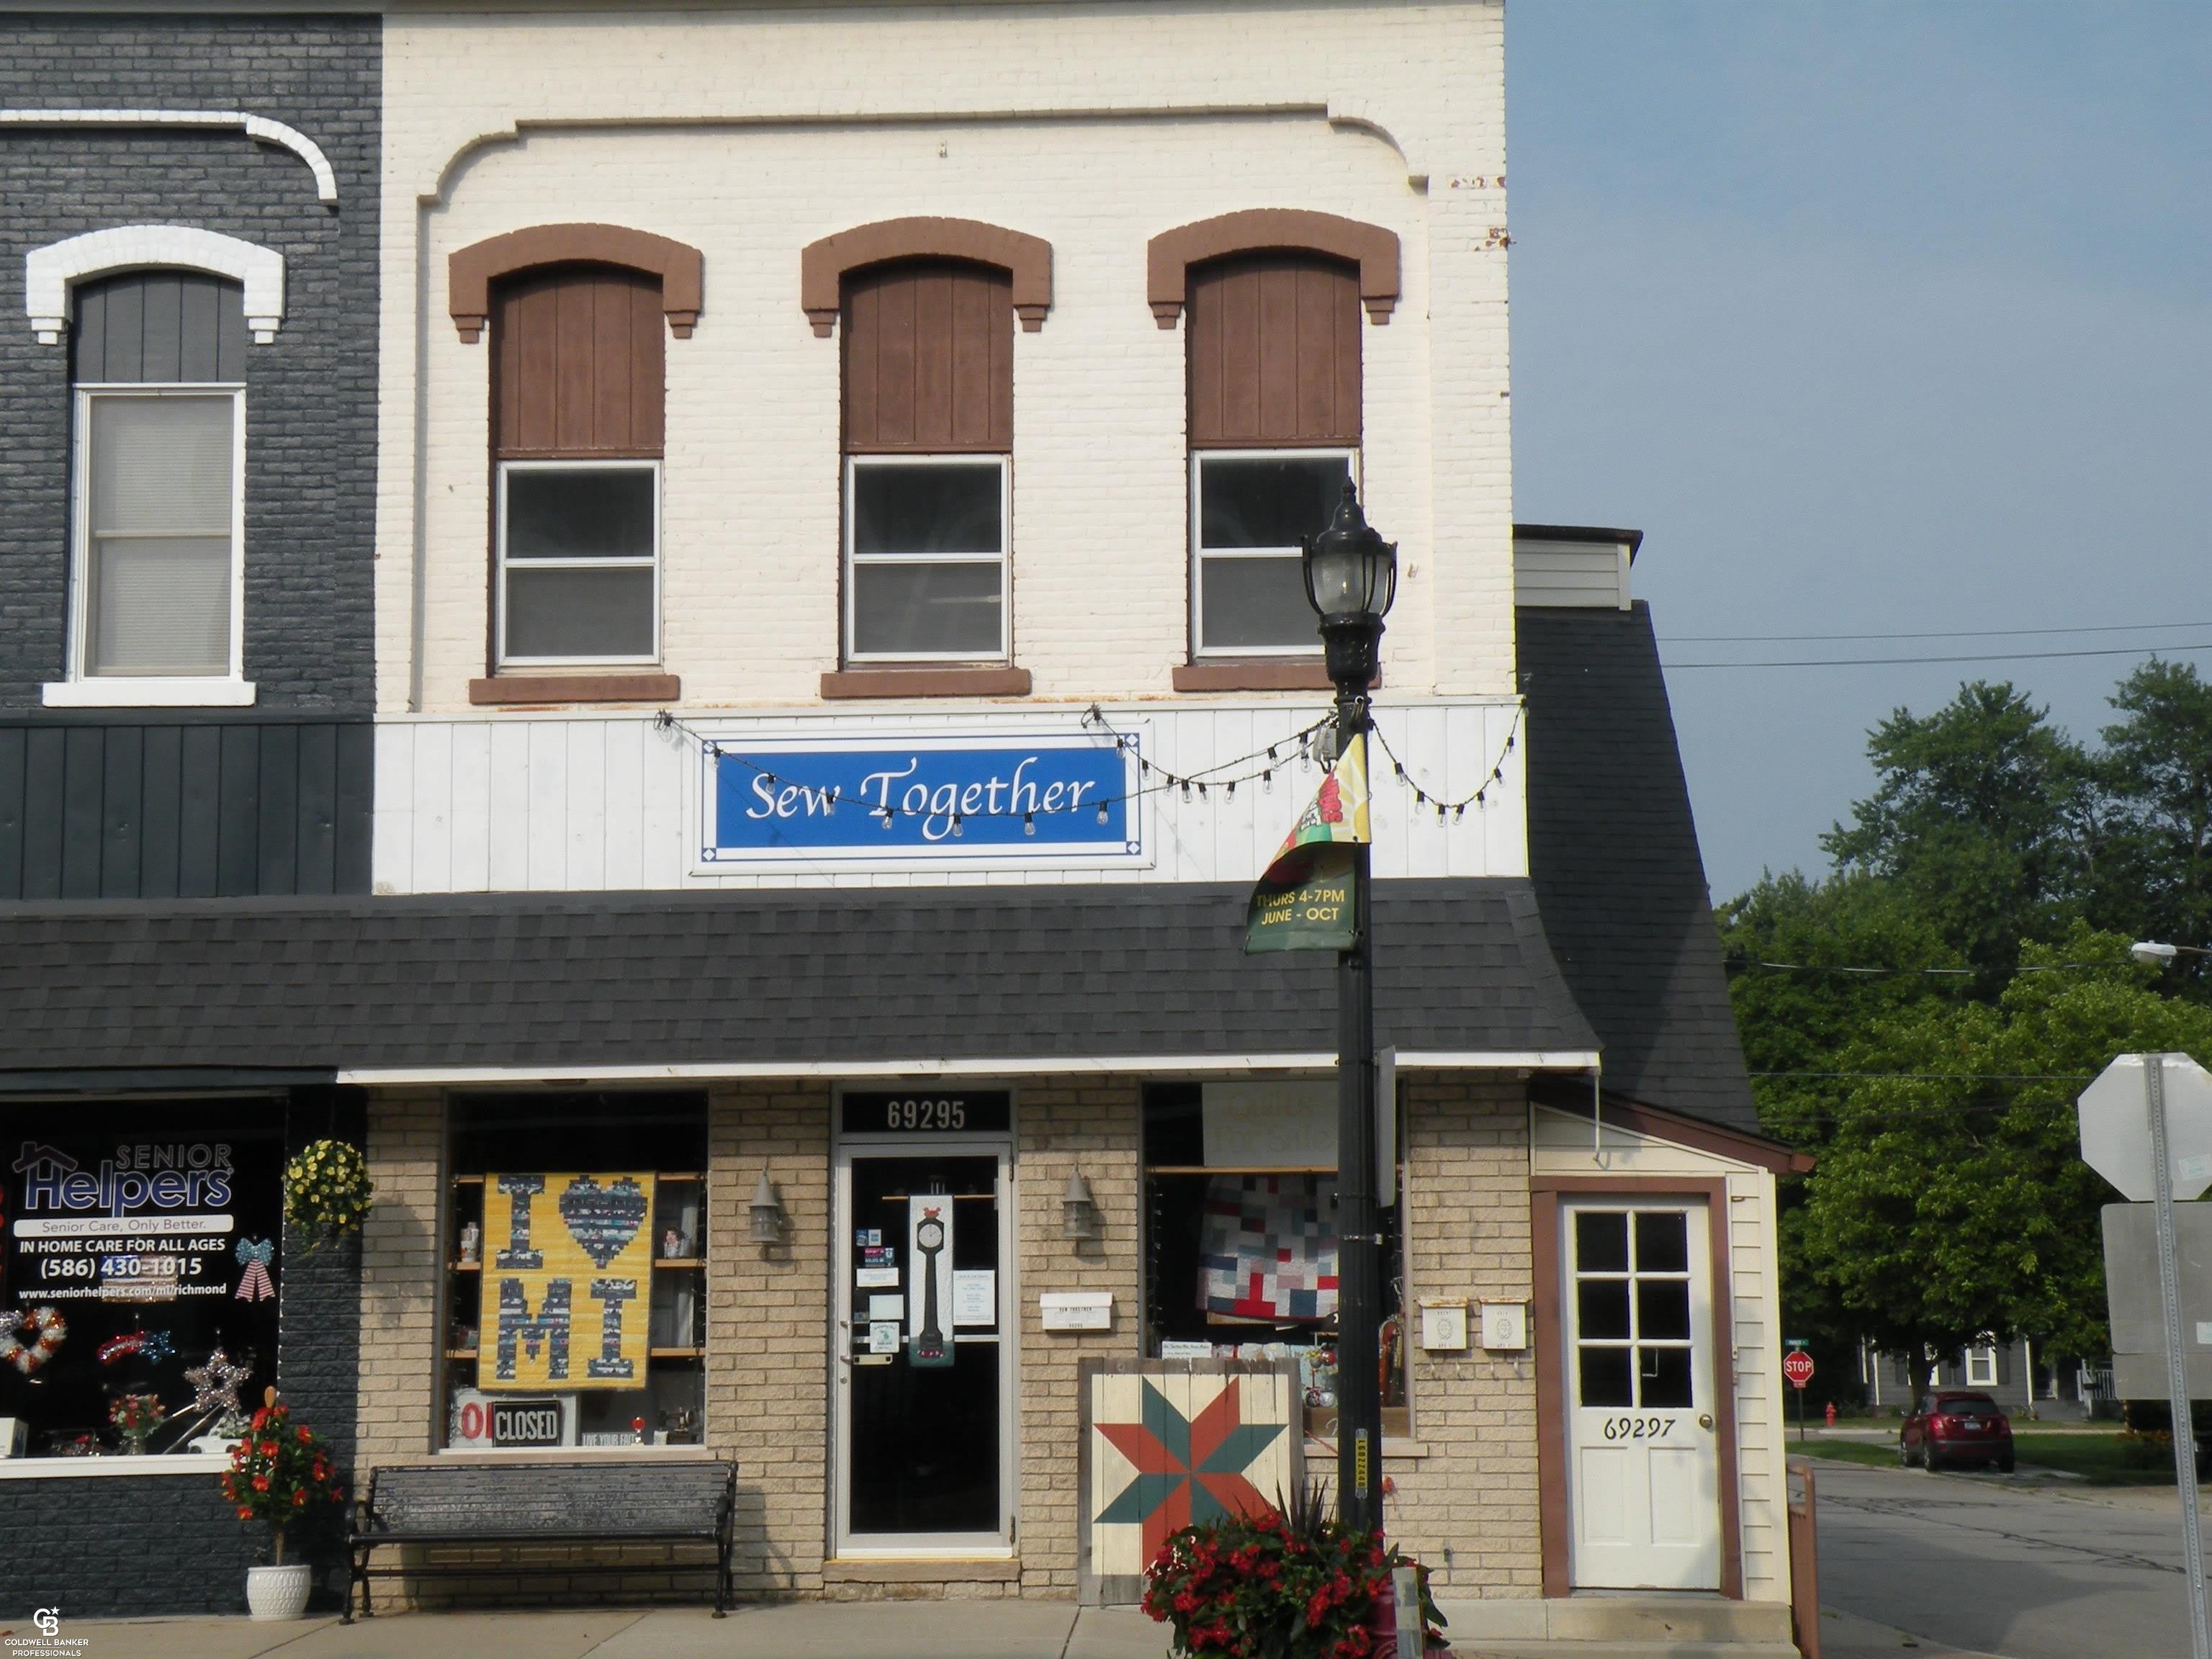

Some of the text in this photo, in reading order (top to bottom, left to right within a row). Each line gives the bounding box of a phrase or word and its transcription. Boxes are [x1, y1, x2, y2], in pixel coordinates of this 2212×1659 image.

[745, 756, 1096, 841] Sew Together
[1256, 889, 1345, 908] THURS 4-7PM
[1262, 909, 1292, 925] JUNE
[1306, 907, 1339, 922] OCT
[887, 1100, 966, 1130] 69295
[116, 1143, 233, 1169] SENIOR
[42, 1219, 207, 1233] Senior Care, Only Better.
[19, 1238, 226, 1253] IN HOME CARE FOR ALL AGES
[40, 1256, 202, 1280] (586) 430-1015
[19, 1282, 228, 1300] www.seniorhelpers.com/mi/richmond
[1786, 1360, 1812, 1372] STOP
[495, 1411, 558, 1441] CLOSED
[1604, 1416, 1676, 1440] 69297
